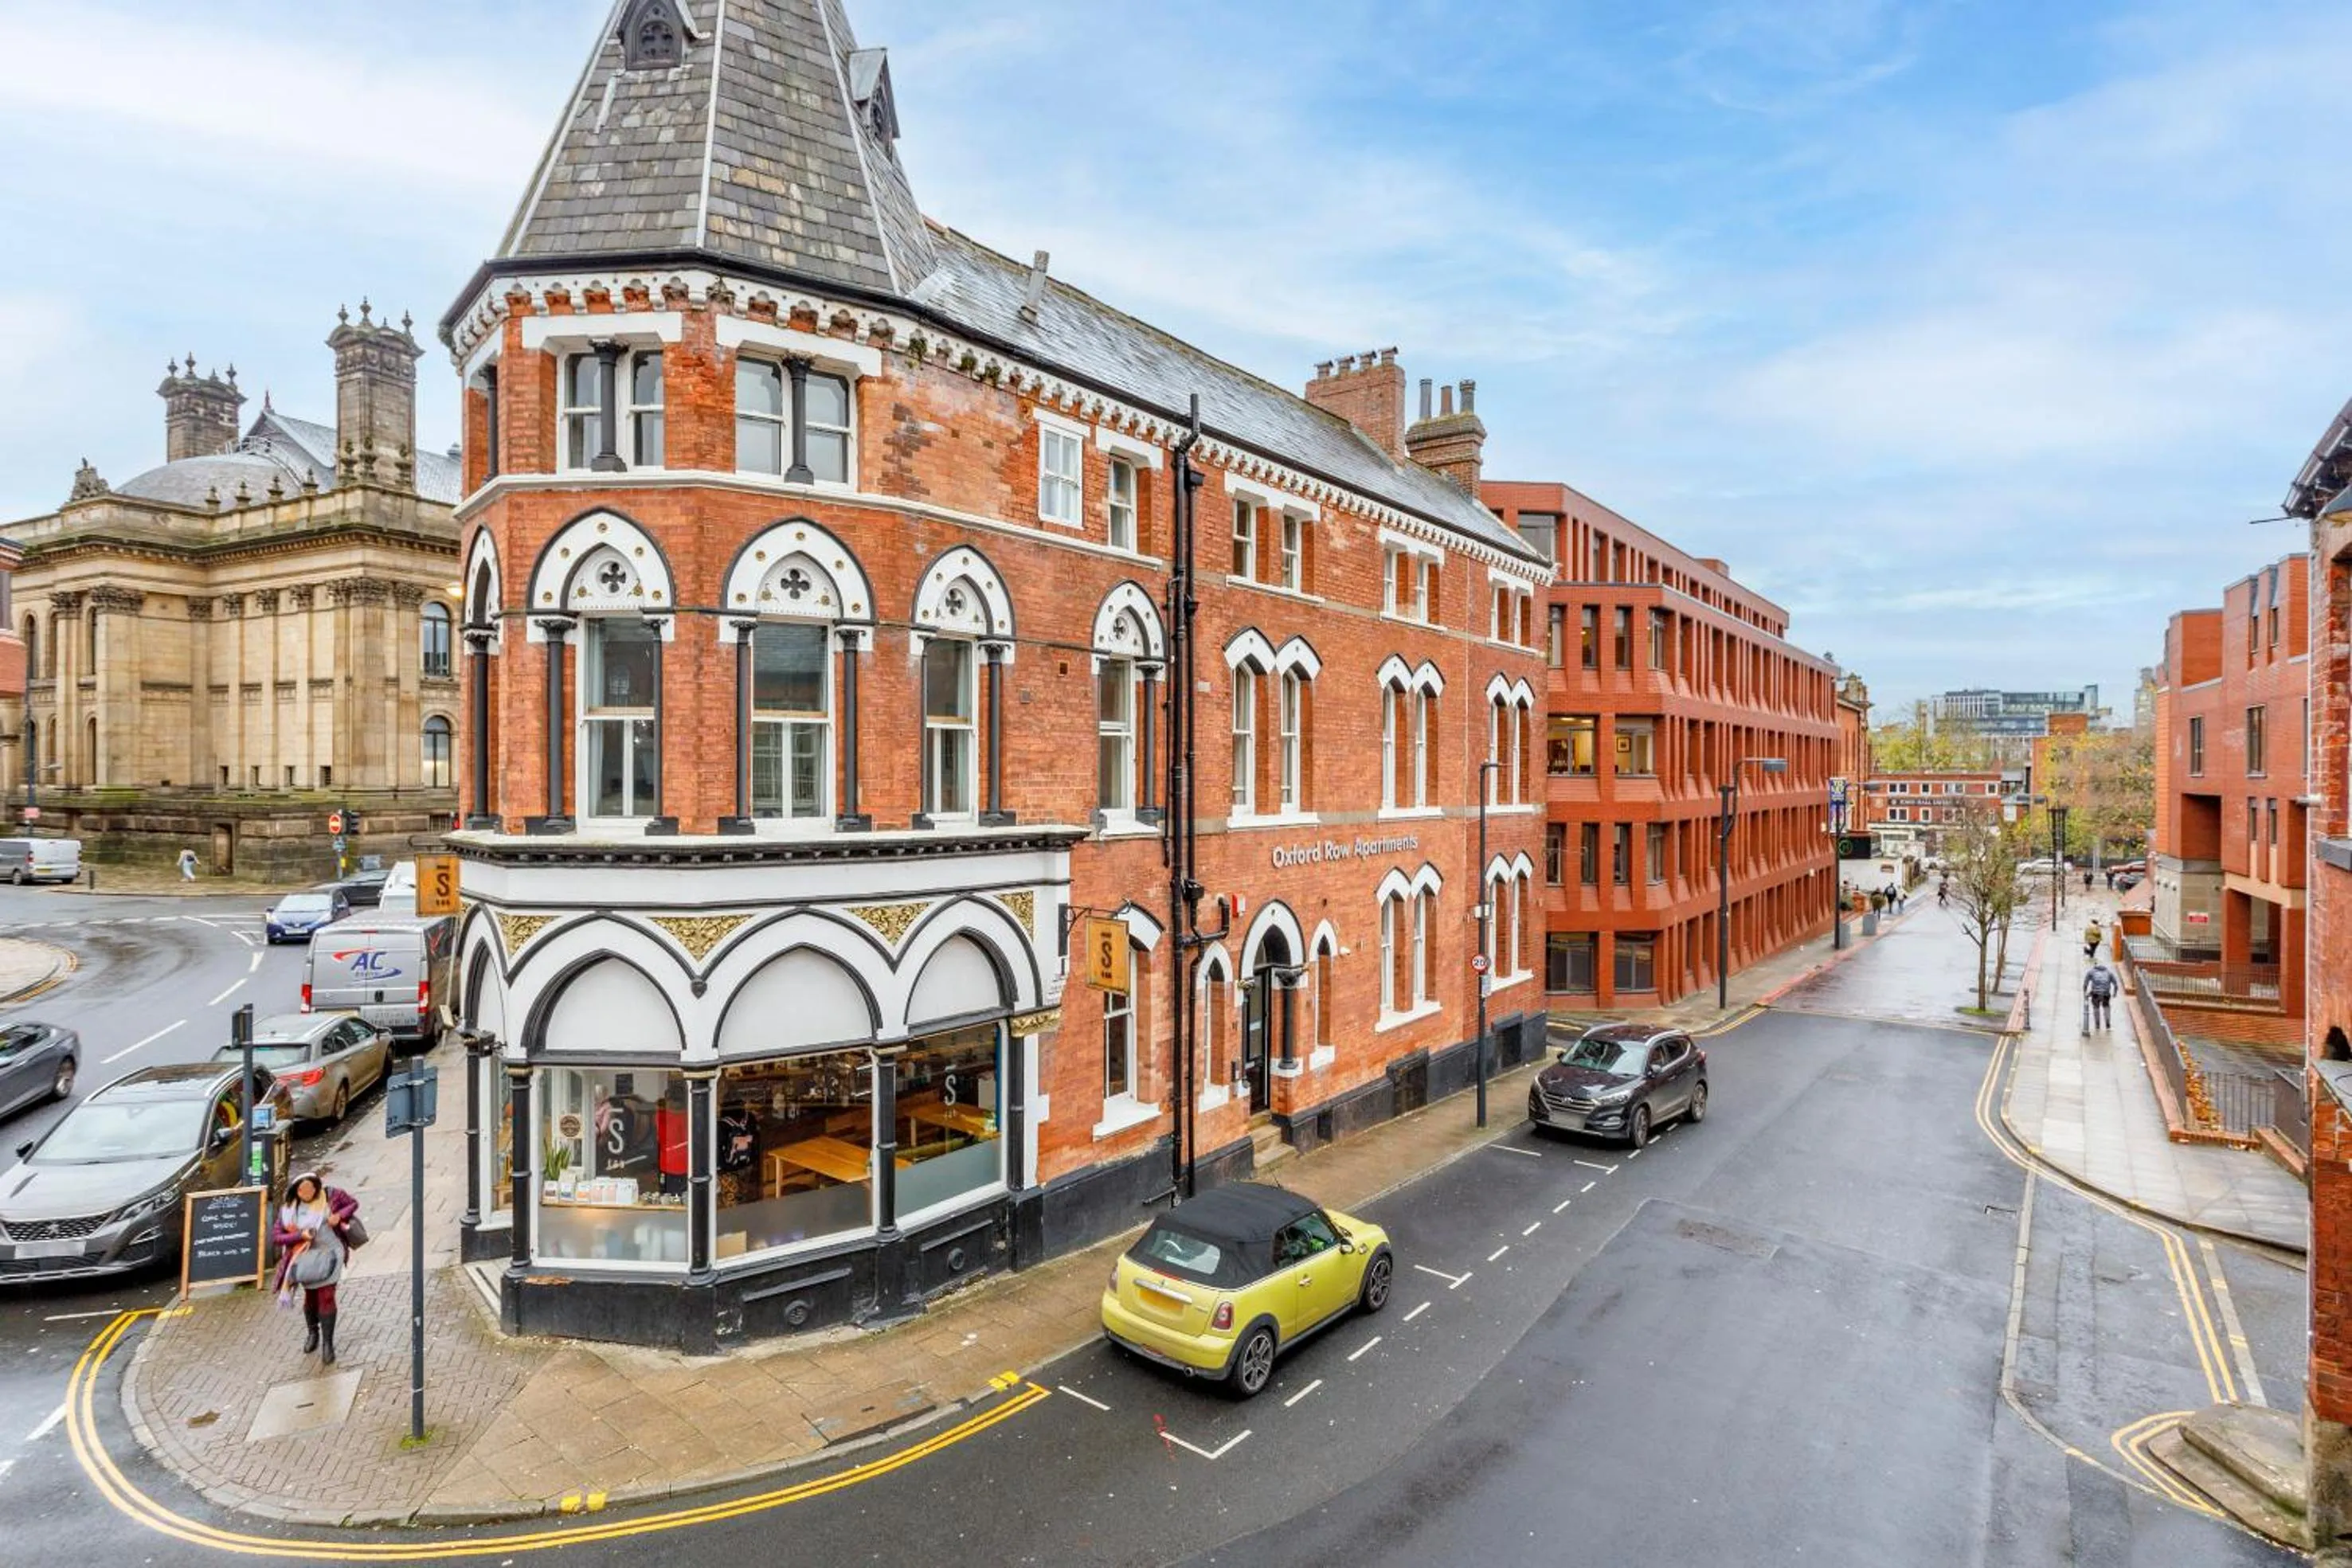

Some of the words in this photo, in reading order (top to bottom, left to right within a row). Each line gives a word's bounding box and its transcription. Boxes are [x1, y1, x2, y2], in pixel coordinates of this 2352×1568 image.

[1273, 841, 1321, 868] Oxford
[1325, 840, 1349, 860] Row
[1355, 835, 1418, 860] Apartments
[436, 873, 450, 897] S
[350, 952, 389, 970] AC
[1102, 940, 1112, 968] S
[1473, 958, 1485, 967] 20
[944, 1074, 956, 1106] S
[608, 1119, 624, 1154] S
